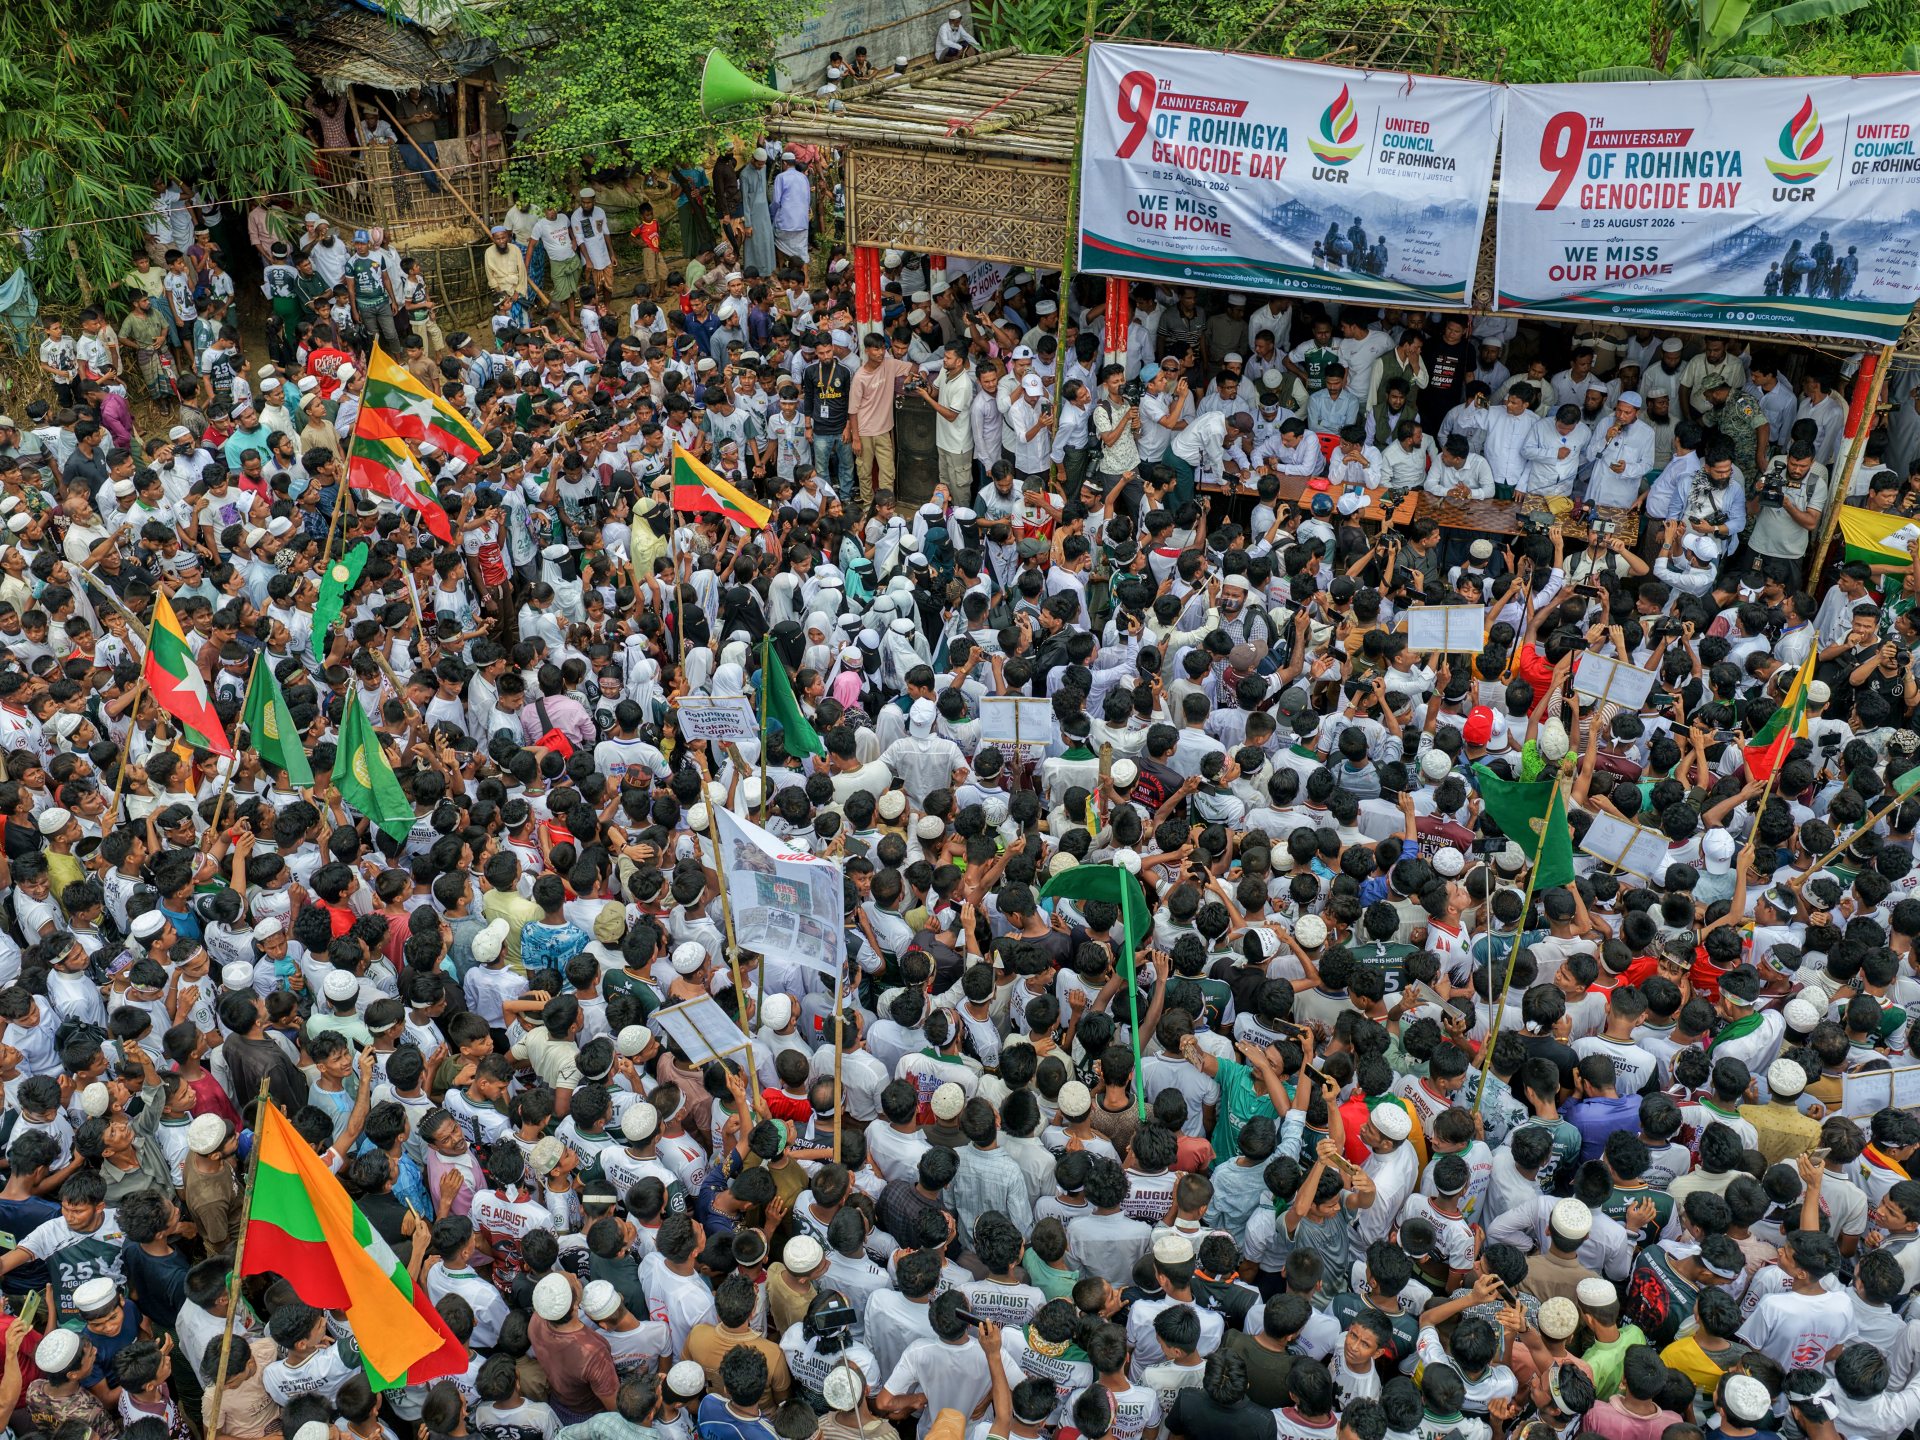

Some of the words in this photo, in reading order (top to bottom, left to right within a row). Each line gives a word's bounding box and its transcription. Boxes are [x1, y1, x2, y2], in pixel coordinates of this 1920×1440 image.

[1158, 79, 1172, 91] TH
[1161, 96, 1238, 114] ANNIVERSARY
[1115, 70, 1157, 159] 9
[1385, 117, 1430, 134] UNITED
[1589, 117, 1604, 129] TH
[1155, 113, 1182, 139] OF
[1187, 116, 1288, 152] ROHINGYA
[1856, 124, 1910, 139] UNITED
[1382, 134, 1434, 152] COUNCIL
[1593, 132, 1682, 146] ANNIVERSARY
[1854, 141, 1916, 157] COUNCIL
[1152, 140, 1243, 176] GENOCIDE
[1249, 153, 1287, 181] DAY
[1379, 150, 1395, 164] OF
[1397, 151, 1456, 171] ROHINGYA
[1535, 111, 1588, 211] 9
[1587, 153, 1617, 179] OF
[1624, 150, 1742, 179] ROHINGYA
[1851, 161, 1869, 175] OF
[1871, 158, 1920, 172] ROHING
[1311, 166, 1349, 184] UCR
[1377, 167, 1396, 176] VOICE
[1401, 170, 1422, 179] UNITY
[1426, 173, 1453, 183] JUSTICE
[1163, 172, 1173, 181] 25
[1175, 173, 1208, 189] AUGUST
[1209, 181, 1230, 191] 2026
[1849, 177, 1869, 186] VOICE
[1876, 177, 1901, 185] UNITY
[1580, 183, 1691, 210] GENOCIDE
[1697, 182, 1742, 209] DAY
[1772, 187, 1816, 202] UCR
[1138, 194, 1168, 211] WE
[1175, 197, 1218, 219] MISS
[1127, 209, 1167, 231] OUR
[1174, 214, 1232, 238] HOME
[1593, 219, 1605, 228] 25
[1607, 219, 1649, 228] AUGUST
[1651, 218, 1675, 228] 2026
[1406, 225, 1416, 234] We
[1417, 230, 1433, 239] carry
[1175, 243, 1194, 251] Dignity
[1881, 232, 1893, 242] We
[1894, 237, 1911, 248] carry
[1411, 246, 1425, 254] hold
[1564, 246, 1598, 262] WE
[1606, 246, 1659, 262] MISS
[1886, 256, 1902, 264] hold
[273, 269, 285, 279] 25
[357, 270, 370, 282] 25
[977, 262, 993, 279] MISS
[1549, 264, 1597, 282] OUR
[1605, 263, 1674, 281] HOME
[978, 270, 1002, 295] HOME
[1873, 276, 1885, 286] We
[1645, 284, 1663, 293] Future
[1622, 306, 1713, 319] www.unitedcouncilofrohingya.org
[1755, 313, 1795, 322] /UCR.OFFICIAL
[213, 364, 229, 373] 25
[1309, 362, 1321, 371] 25
[708, 727, 744, 737] dignity
[411, 830, 437, 838] AUGUS
[1426, 834, 1454, 846] AUGUST
[1901, 876, 1918, 888] 25
[1243, 1031, 1252, 1040] 25
[1254, 1036, 1270, 1047] AUG
[918, 1072, 927, 1081] 25
[1404, 1084, 1414, 1095] 25
[1412, 1092, 1434, 1117] AUGUST
[560, 1132, 568, 1145] 25
[569, 1140, 596, 1164] AUGUST
[610, 1167, 618, 1178] 25
[692, 1171, 704, 1182] 25
[672, 1195, 685, 1207] 25
[481, 1204, 492, 1217] 25
[493, 1206, 528, 1228] AUGUST
[1420, 1210, 1429, 1218] 25
[1429, 1214, 1447, 1231] AUGUST
[59, 1261, 93, 1281] 25
[1359, 1280, 1371, 1292] 25
[1782, 1278, 1793, 1287] 25
[974, 1293, 988, 1304] 25
[989, 1294, 1030, 1308] AUGUST
[793, 1350, 805, 1363] 25
[807, 1358, 835, 1373] AUGUS
[1022, 1347, 1035, 1358] 25
[1035, 1352, 1072, 1372] AUGUST
[278, 1385, 290, 1393] 25
[293, 1376, 329, 1392] AUGUST
[1163, 1389, 1176, 1399] 25
[1117, 1404, 1144, 1415] GUST
[494, 1427, 520, 1440] 25
